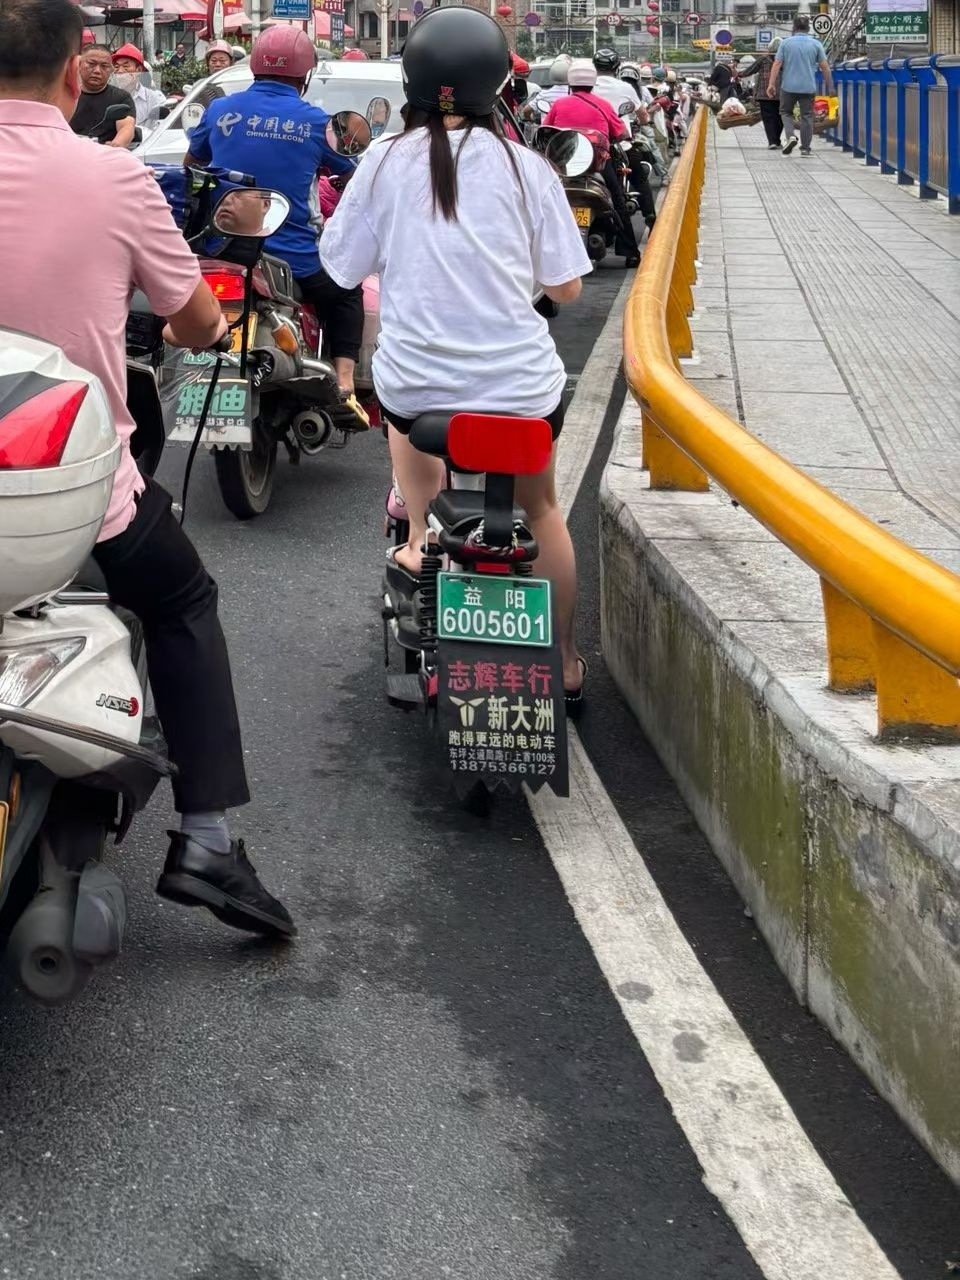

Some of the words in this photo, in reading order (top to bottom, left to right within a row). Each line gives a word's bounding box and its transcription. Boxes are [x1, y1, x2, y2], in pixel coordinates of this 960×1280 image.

[816, 20, 829, 30] 30
[247, 115, 312, 138] 中国电信
[270, 131, 304, 143] TELECOM
[464, 586, 526, 610] 益阳
[442, 607, 545, 640] 6005601
[447, 661, 552, 695] 志辉车行
[487, 695, 555, 733] 新大洲
[448, 730, 556, 750] 跑得更远的电动车
[450, 760, 556, 776] 13875366127
